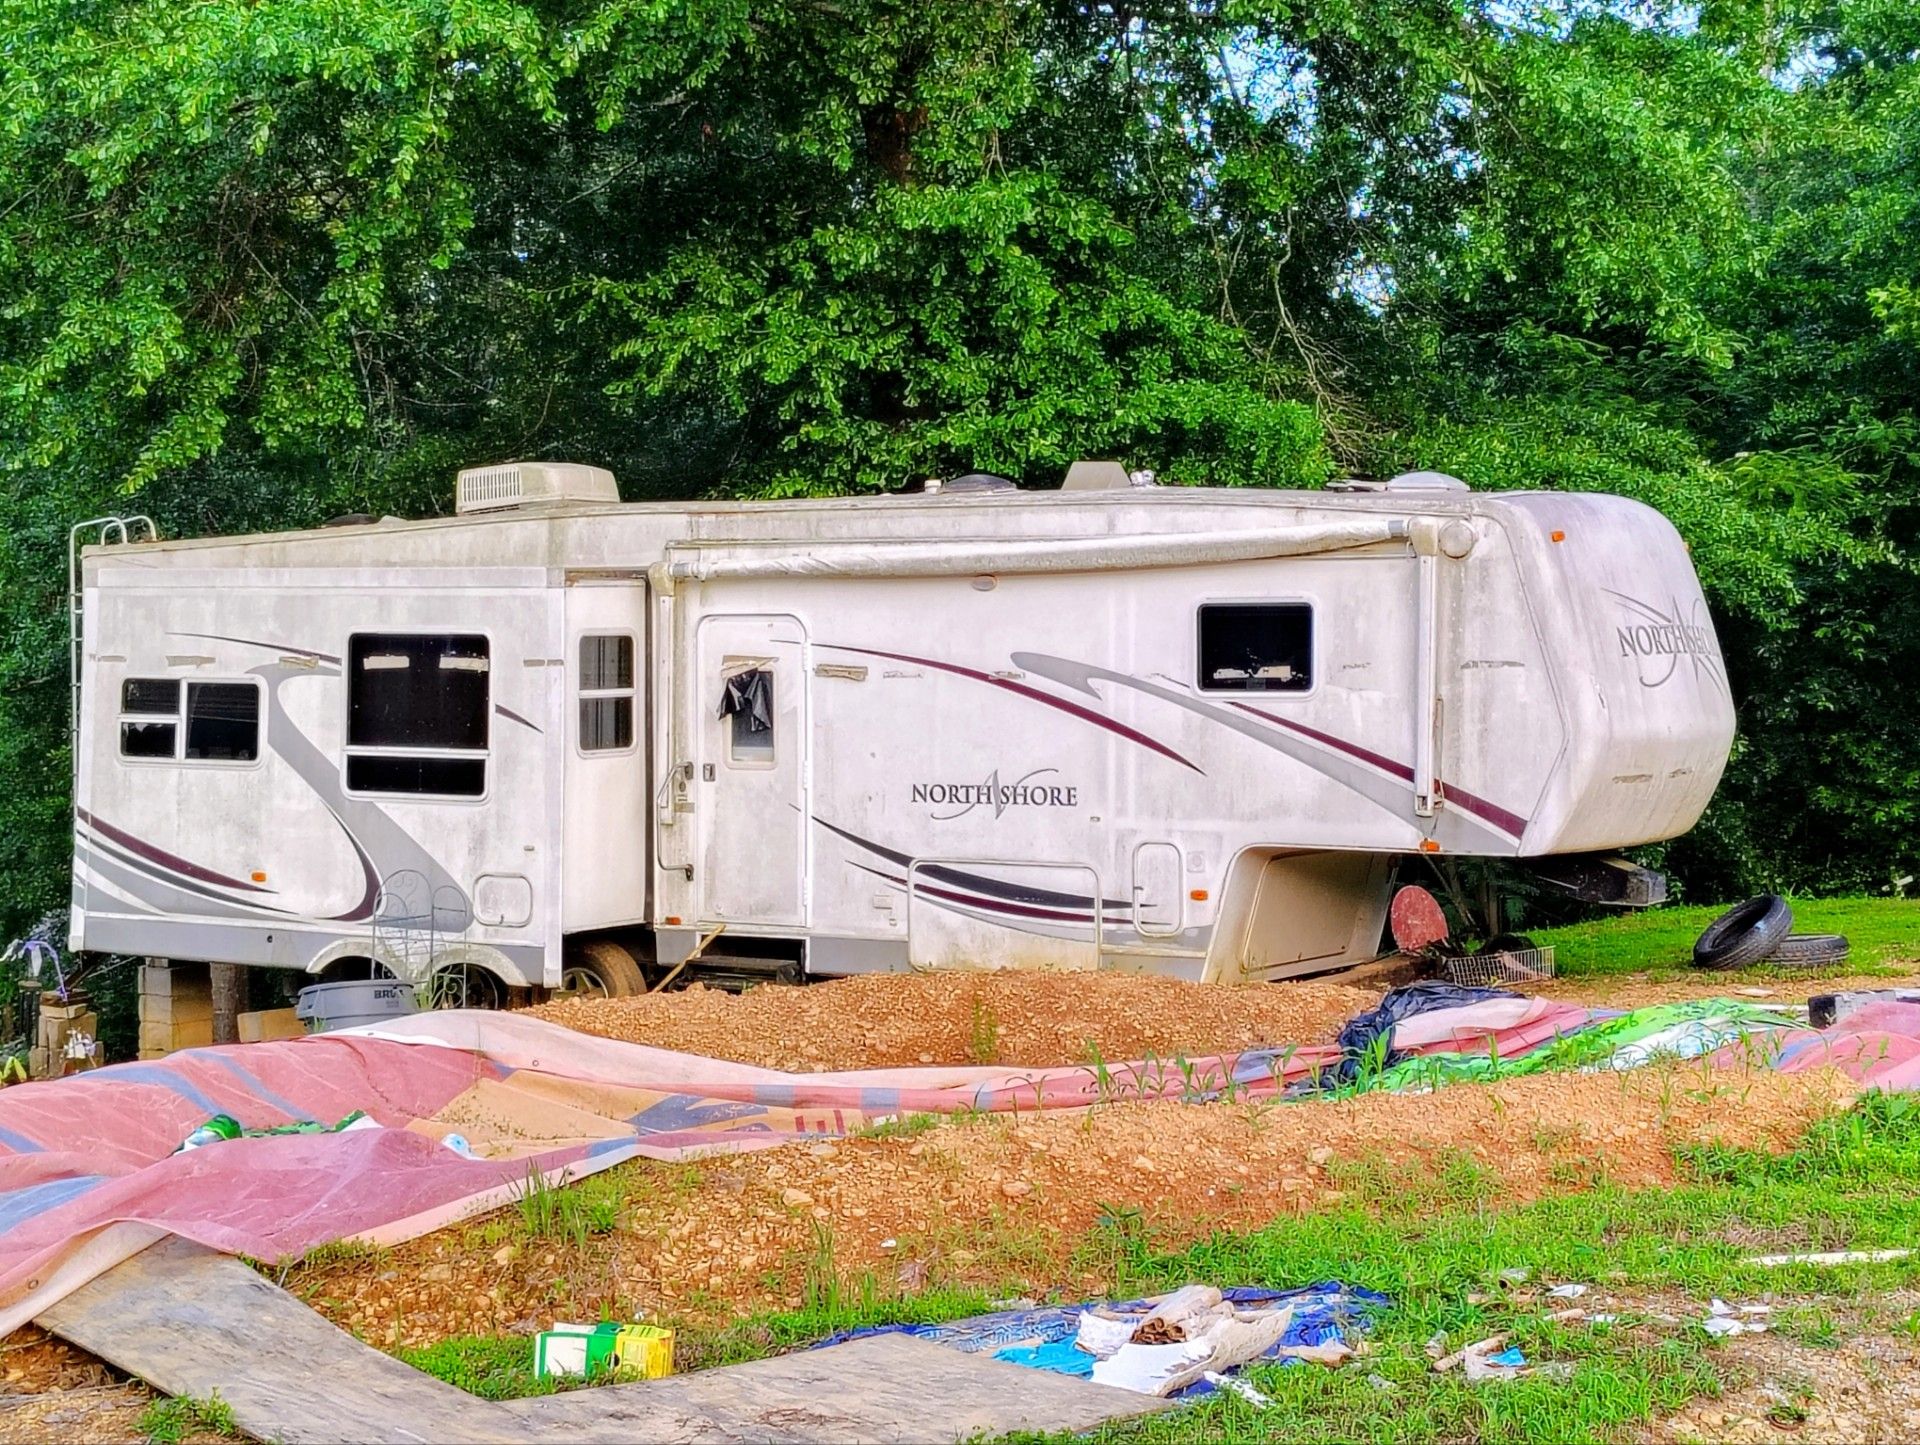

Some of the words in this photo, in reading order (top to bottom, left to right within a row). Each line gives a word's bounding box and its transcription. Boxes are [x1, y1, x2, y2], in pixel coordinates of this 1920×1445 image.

[1617, 625, 1687, 657] NORTH
[911, 784, 992, 804] NORTH
[1000, 786, 1078, 807] SHORE
